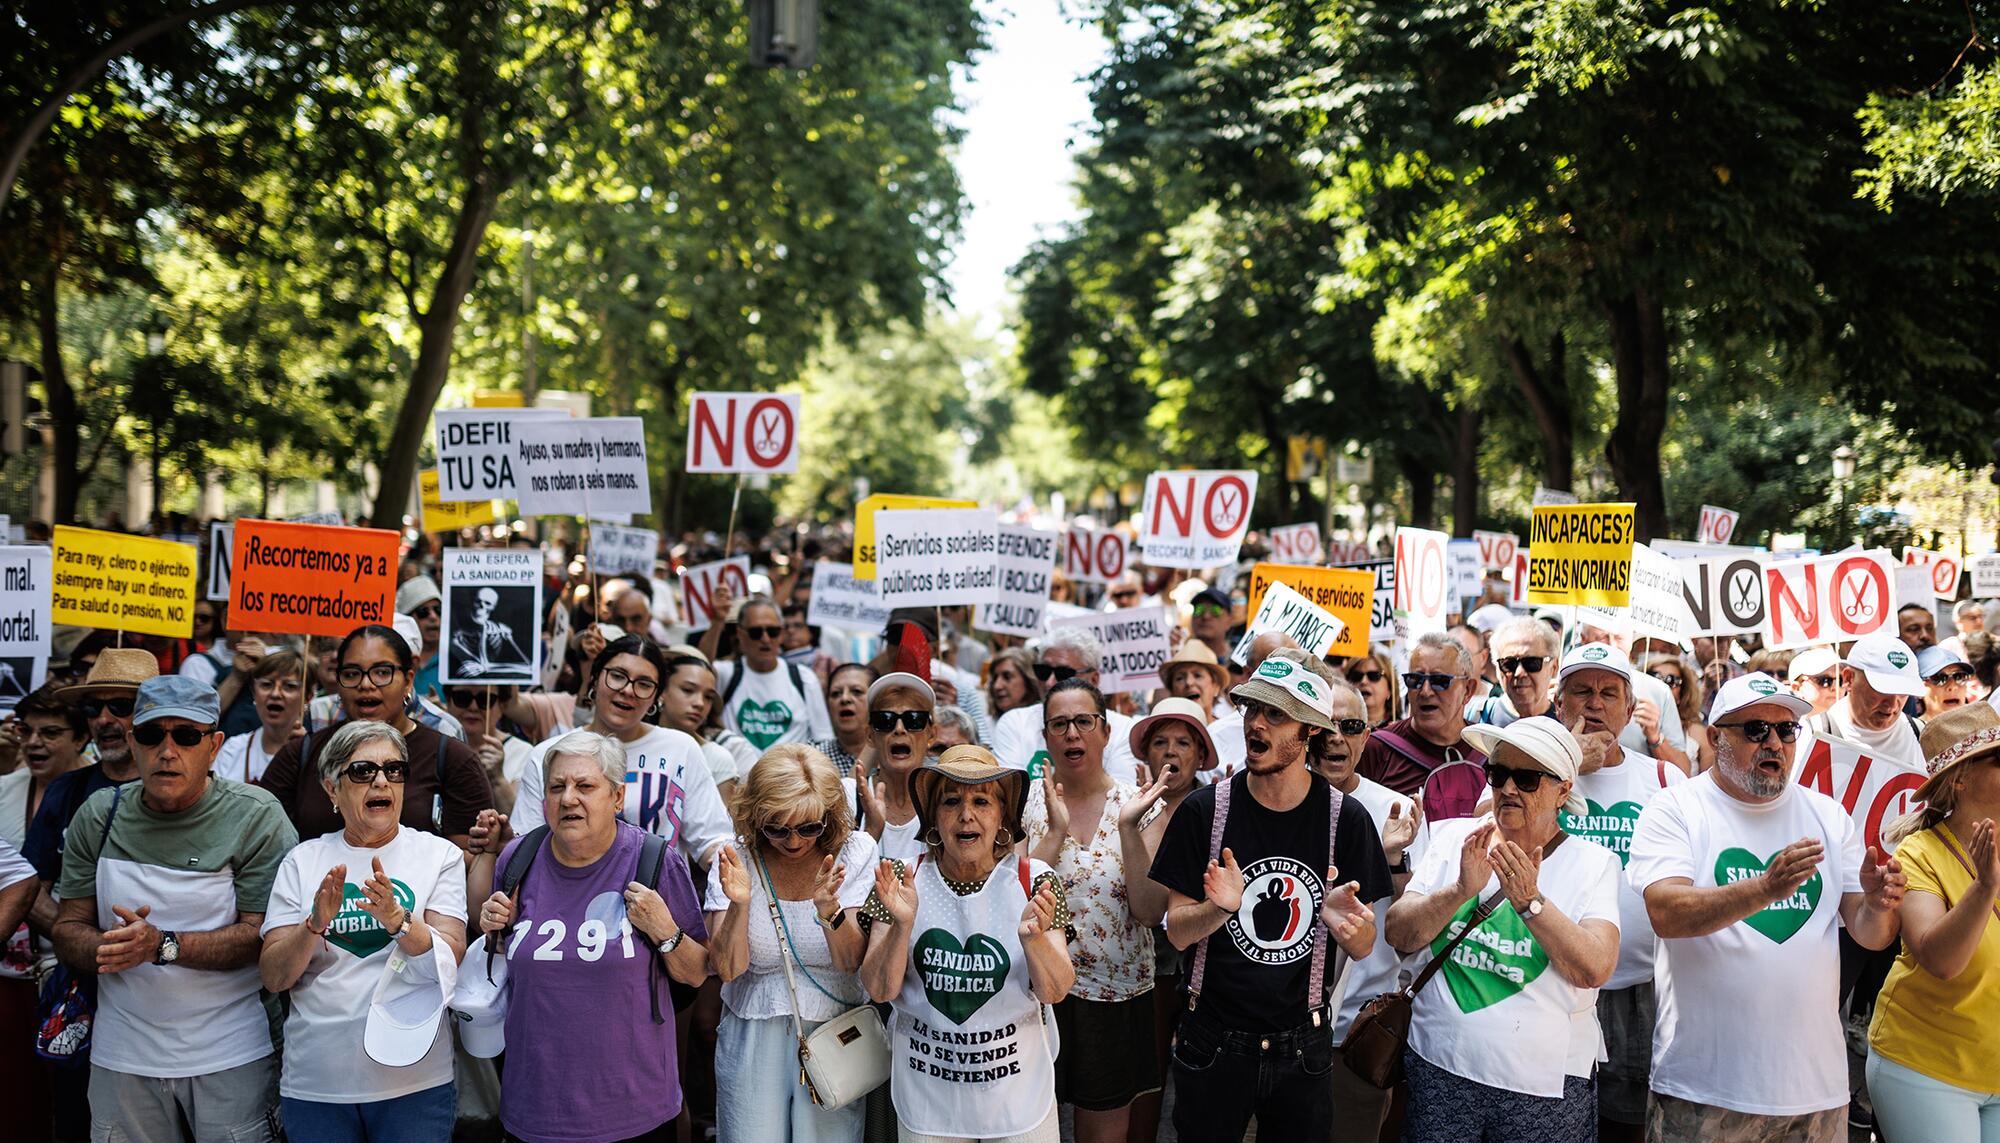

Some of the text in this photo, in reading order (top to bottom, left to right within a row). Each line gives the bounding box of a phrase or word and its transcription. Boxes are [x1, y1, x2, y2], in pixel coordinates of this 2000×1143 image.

[693, 398, 794, 468] NO
[519, 437, 644, 466] Ayuso, su madre y hermano,
[442, 456, 473, 490] TU
[531, 471, 639, 492] nos roban a seis manos.
[1151, 476, 1249, 540] NO
[1272, 527, 1317, 558] NO
[1532, 512, 1633, 545] INCAPACES?
[1702, 510, 1733, 544] NO
[56, 546, 190, 577] Para rey, clero o ejército
[243, 535, 387, 583] ¡Recortemos ya a
[457, 551, 530, 565] AÚN ESPERA
[880, 530, 995, 564] ¡Servicios sociales
[1068, 530, 1125, 580] NO
[5, 558, 35, 591] mal.
[55, 571, 188, 600] siempre hay un dinero.
[452, 571, 535, 581] LA SANIDAD PP
[882, 565, 996, 600] públicos de calidad!
[1005, 569, 1046, 594] BOLSA
[1394, 534, 1444, 618] NO
[1529, 558, 1631, 592] ESTAS NORMAS!
[53, 593, 186, 623] Para salud o pensión, NO.
[240, 581, 384, 622] los recortadores!
[683, 564, 749, 627] NO
[1315, 583, 1365, 609] servicios
[1683, 559, 1765, 631] NO
[1767, 556, 1890, 645] NO
[0, 608, 39, 642] ortal.
[984, 603, 993, 624] Y
[1104, 619, 1165, 643] UNIVERSAL,
[639, 754, 684, 778] ORK
[624, 772, 686, 848] KS
[1252, 863, 1268, 879] LA
[1270, 860, 1299, 875] VIDA
[1298, 871, 1324, 908] RURAL
[1229, 919, 1317, 963] ODIA AL SEÑORITO
[923, 947, 996, 972] SANIDAD
[924, 967, 996, 993] PÚBLICA
[912, 1018, 1017, 1046] LA SANIDAD
[909, 1037, 1018, 1065] NO SE VENDE
[909, 1056, 1021, 1084] SE DEFIENDE
